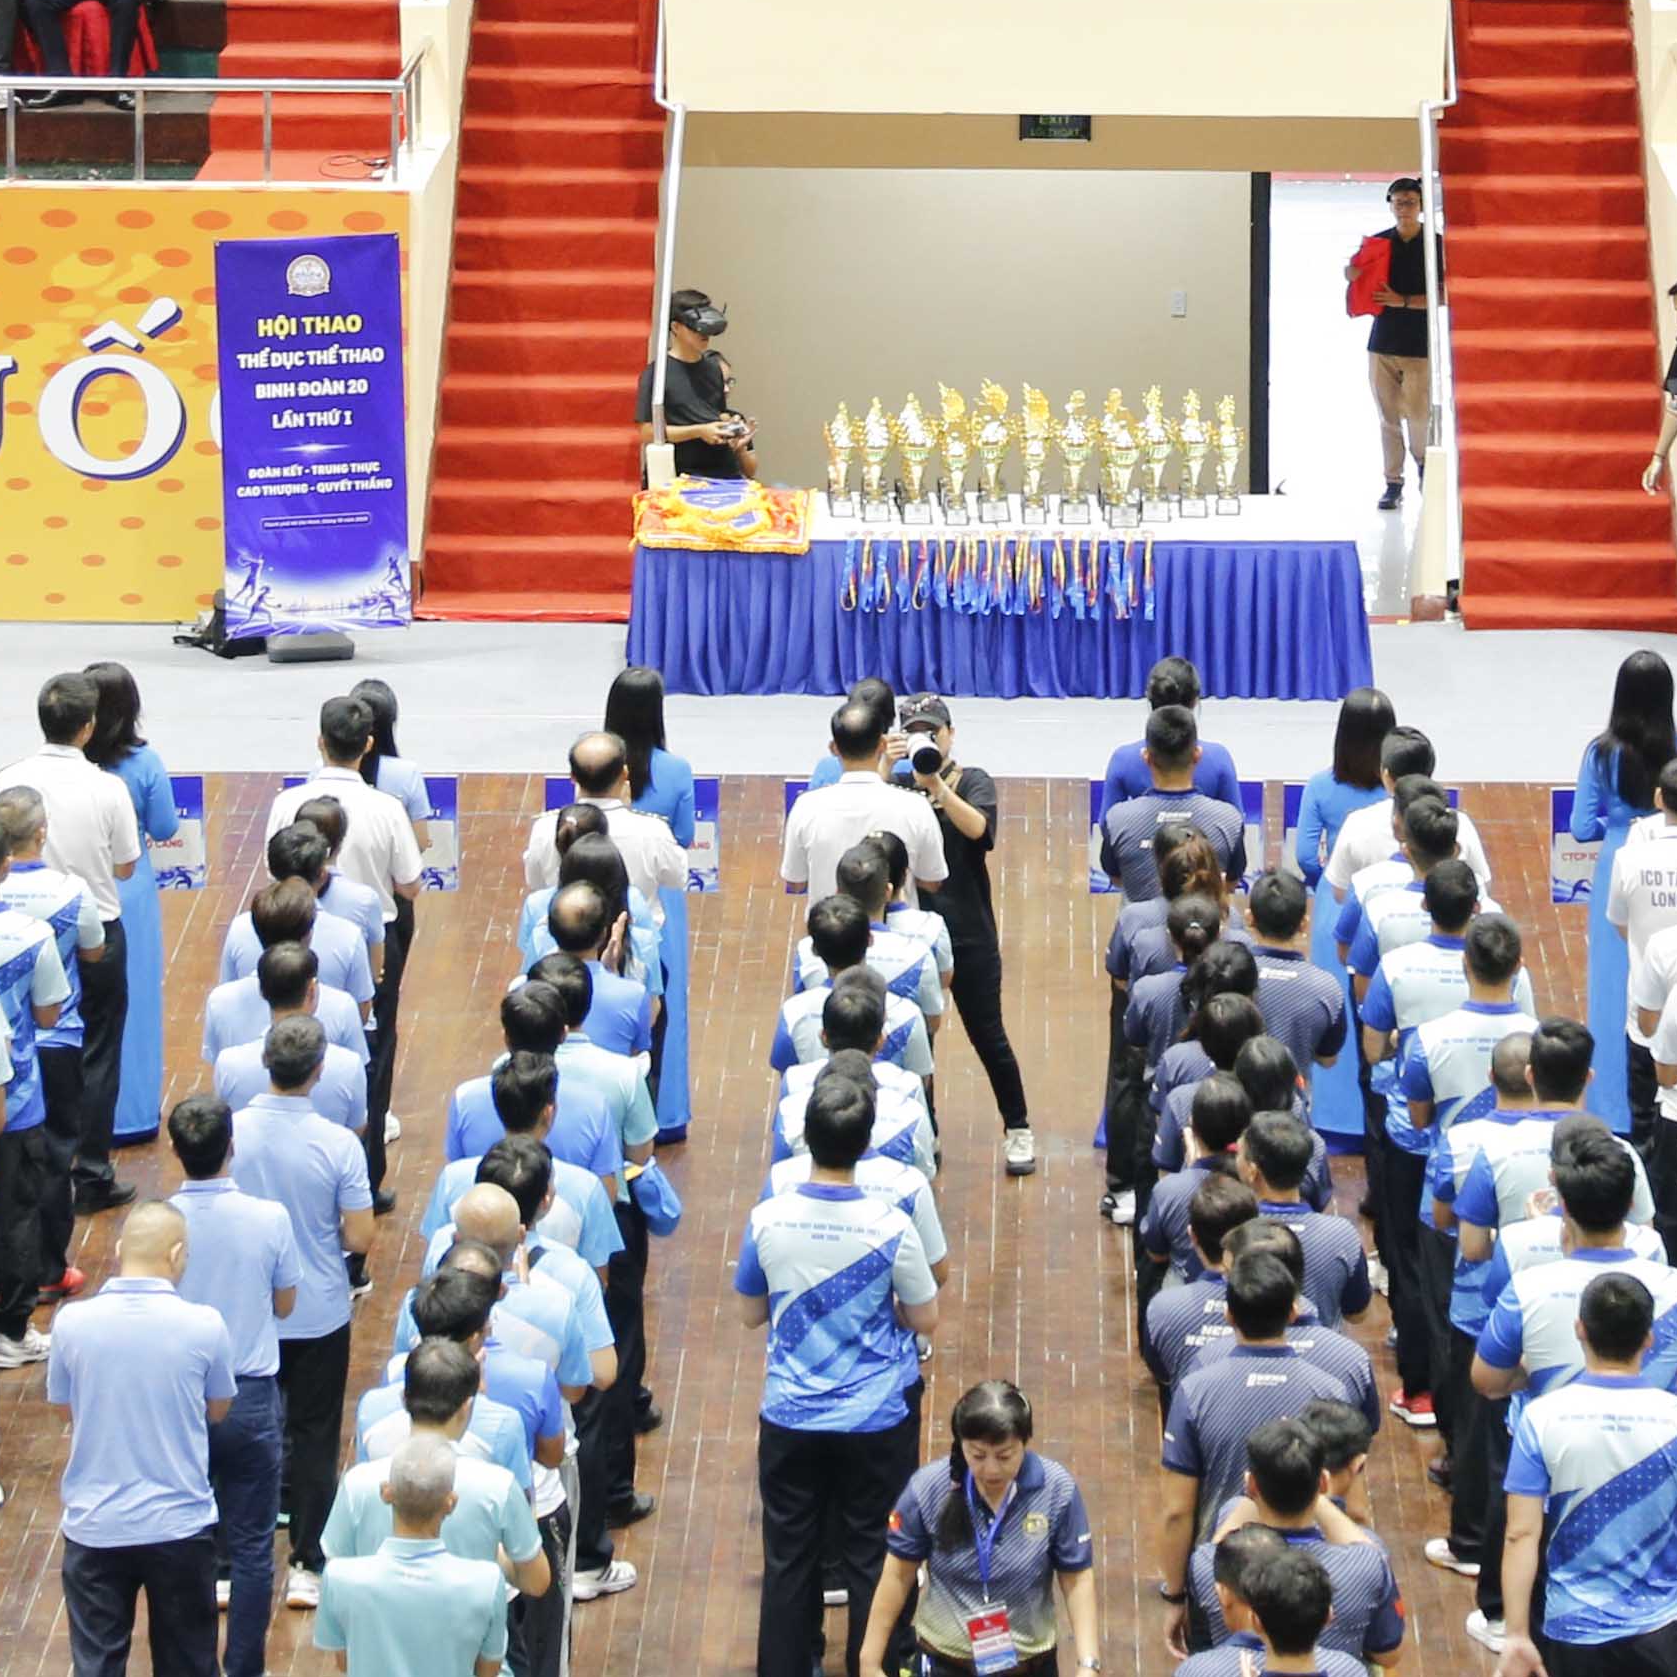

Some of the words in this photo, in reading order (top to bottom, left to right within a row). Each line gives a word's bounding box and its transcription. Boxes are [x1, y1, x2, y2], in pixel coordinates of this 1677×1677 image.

[257, 314, 297, 339] HỘI
[300, 314, 363, 335] THAO
[236, 347, 272, 370] THỂ
[272, 352, 305, 371] DỤC
[306, 345, 341, 368] THỂ
[337, 346, 385, 365] THAO
[254, 380, 296, 400] BINH
[297, 378, 346, 399] ĐOÀN
[346, 378, 368, 395] 20
[306, 407, 342, 427] THỨ
[343, 410, 353, 426] I
[1640, 870, 1662, 886] ICD
